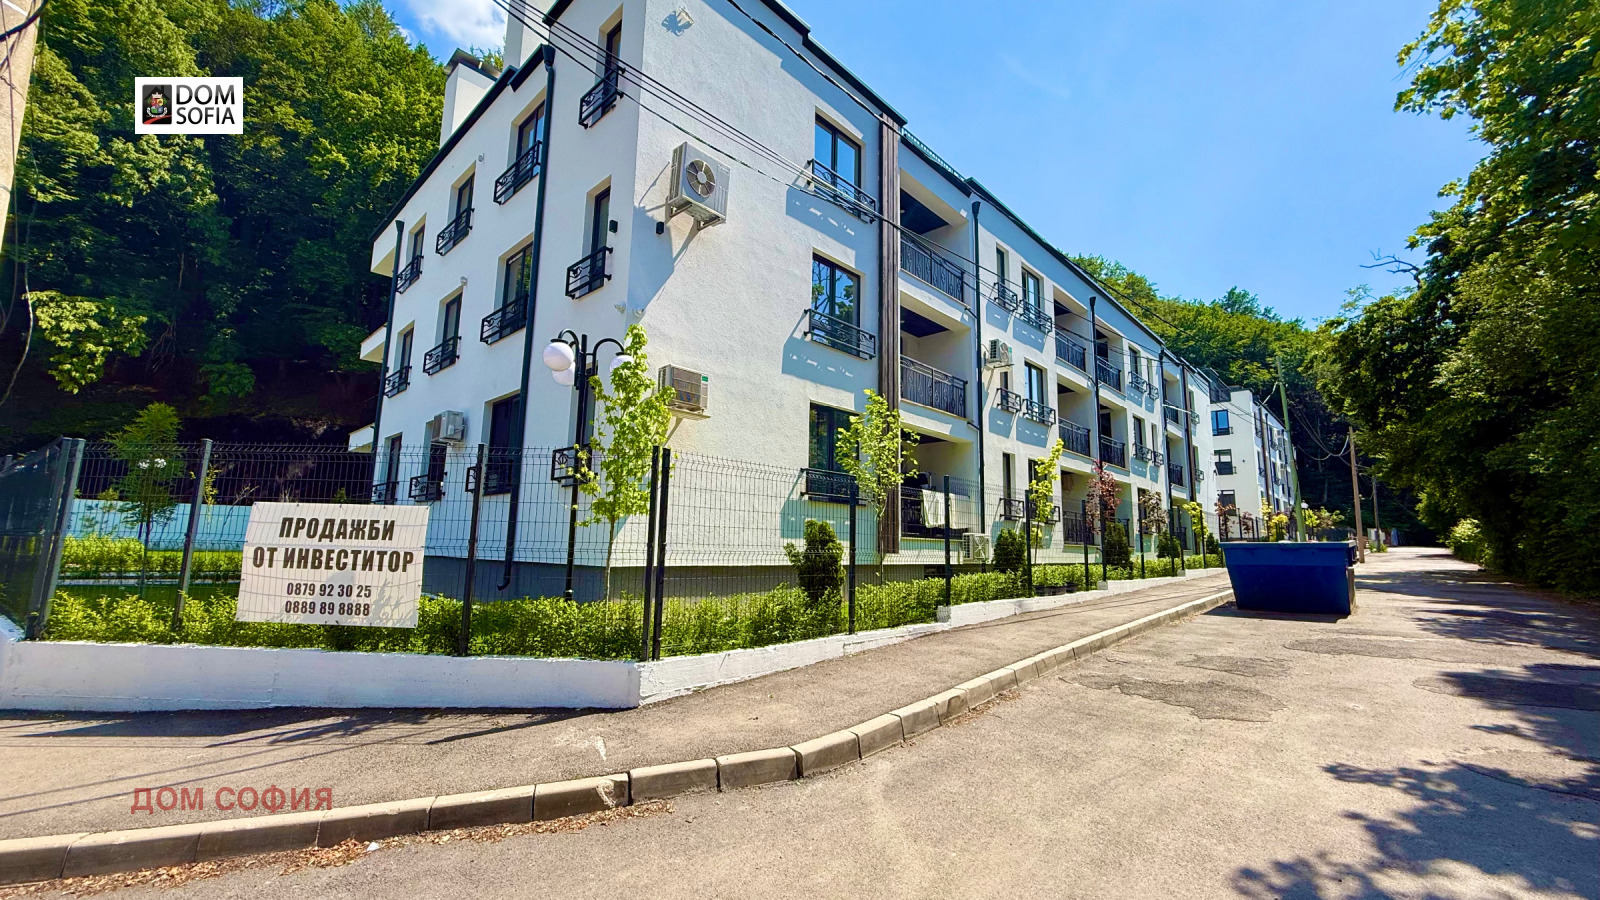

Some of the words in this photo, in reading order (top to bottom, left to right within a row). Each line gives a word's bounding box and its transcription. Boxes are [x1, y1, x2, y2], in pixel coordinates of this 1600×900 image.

[279, 517, 395, 542] ПРОДАЖБИ
[252, 547, 278, 569] ОТ
[282, 548, 414, 572] ИНВЕСТИТОР
[286, 583, 316, 596] 0879
[319, 584, 334, 597] 92
[337, 584, 353, 598] 30
[356, 585, 372, 598] 25
[284, 601, 316, 614] 0889
[319, 601, 335, 615] 89
[338, 603, 370, 616] 8888
